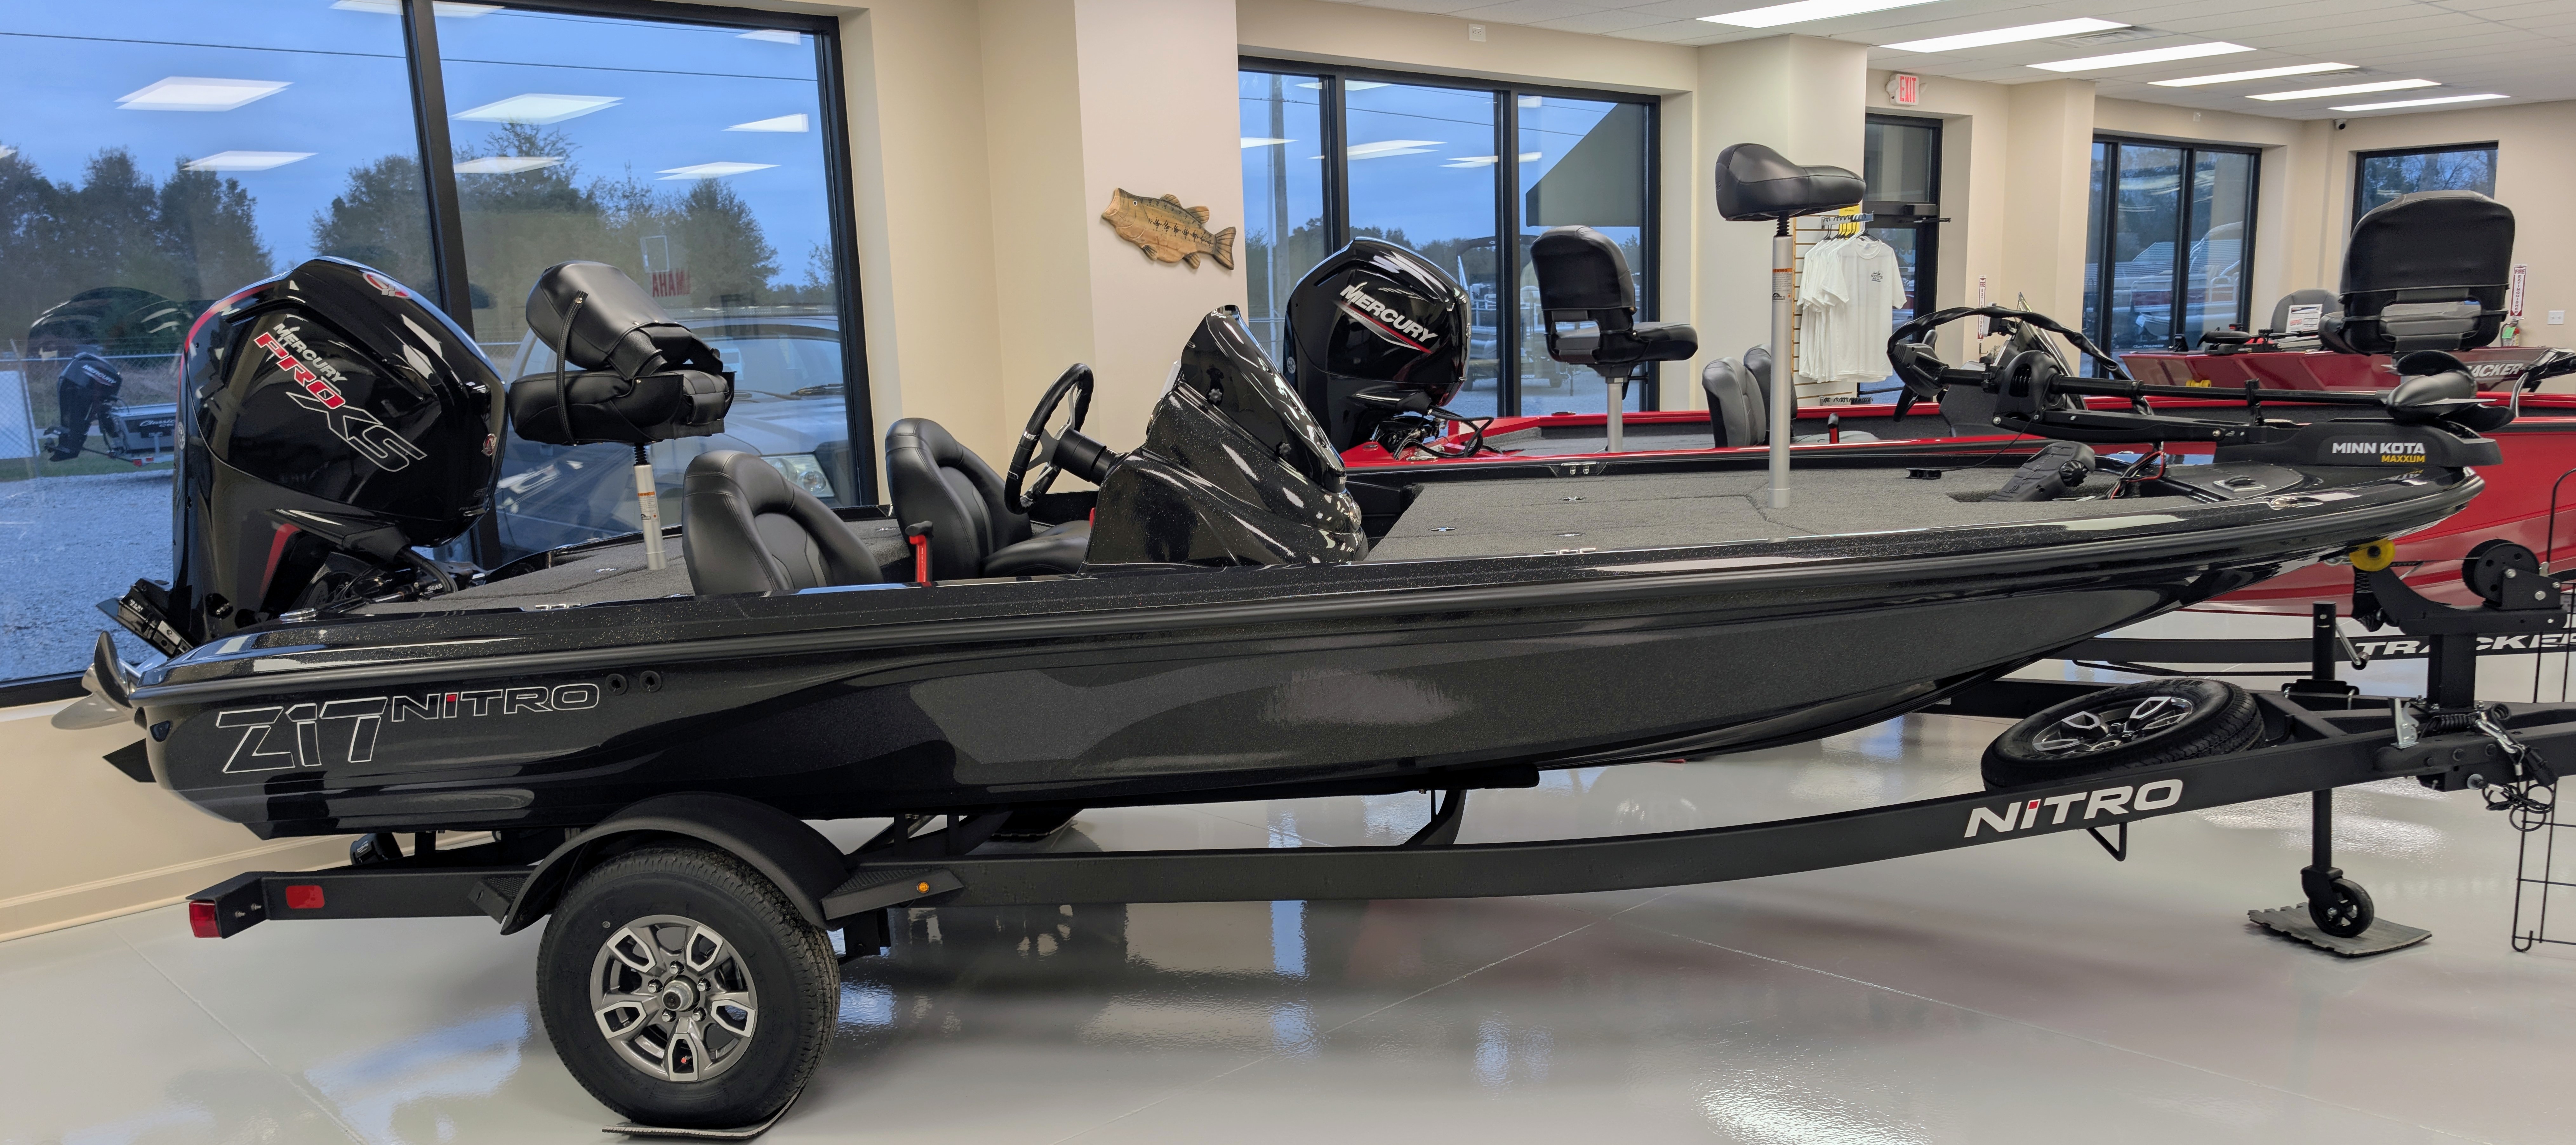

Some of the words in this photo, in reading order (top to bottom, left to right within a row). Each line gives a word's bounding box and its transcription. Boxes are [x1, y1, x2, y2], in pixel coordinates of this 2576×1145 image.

[1900, 76, 1916, 103] EXIT
[1340, 284, 1438, 342] MERCURY
[82, 364, 116, 384] MERCURY
[254, 332, 346, 409] PRO
[273, 323, 348, 382] MERCURY
[2467, 363, 2524, 377] ACKER
[286, 391, 427, 472] XS
[2332, 443, 2377, 453] MINN
[2380, 443, 2426, 454] KOTA
[391, 683, 600, 722] NITRO
[1964, 779, 2183, 838] NITRO
